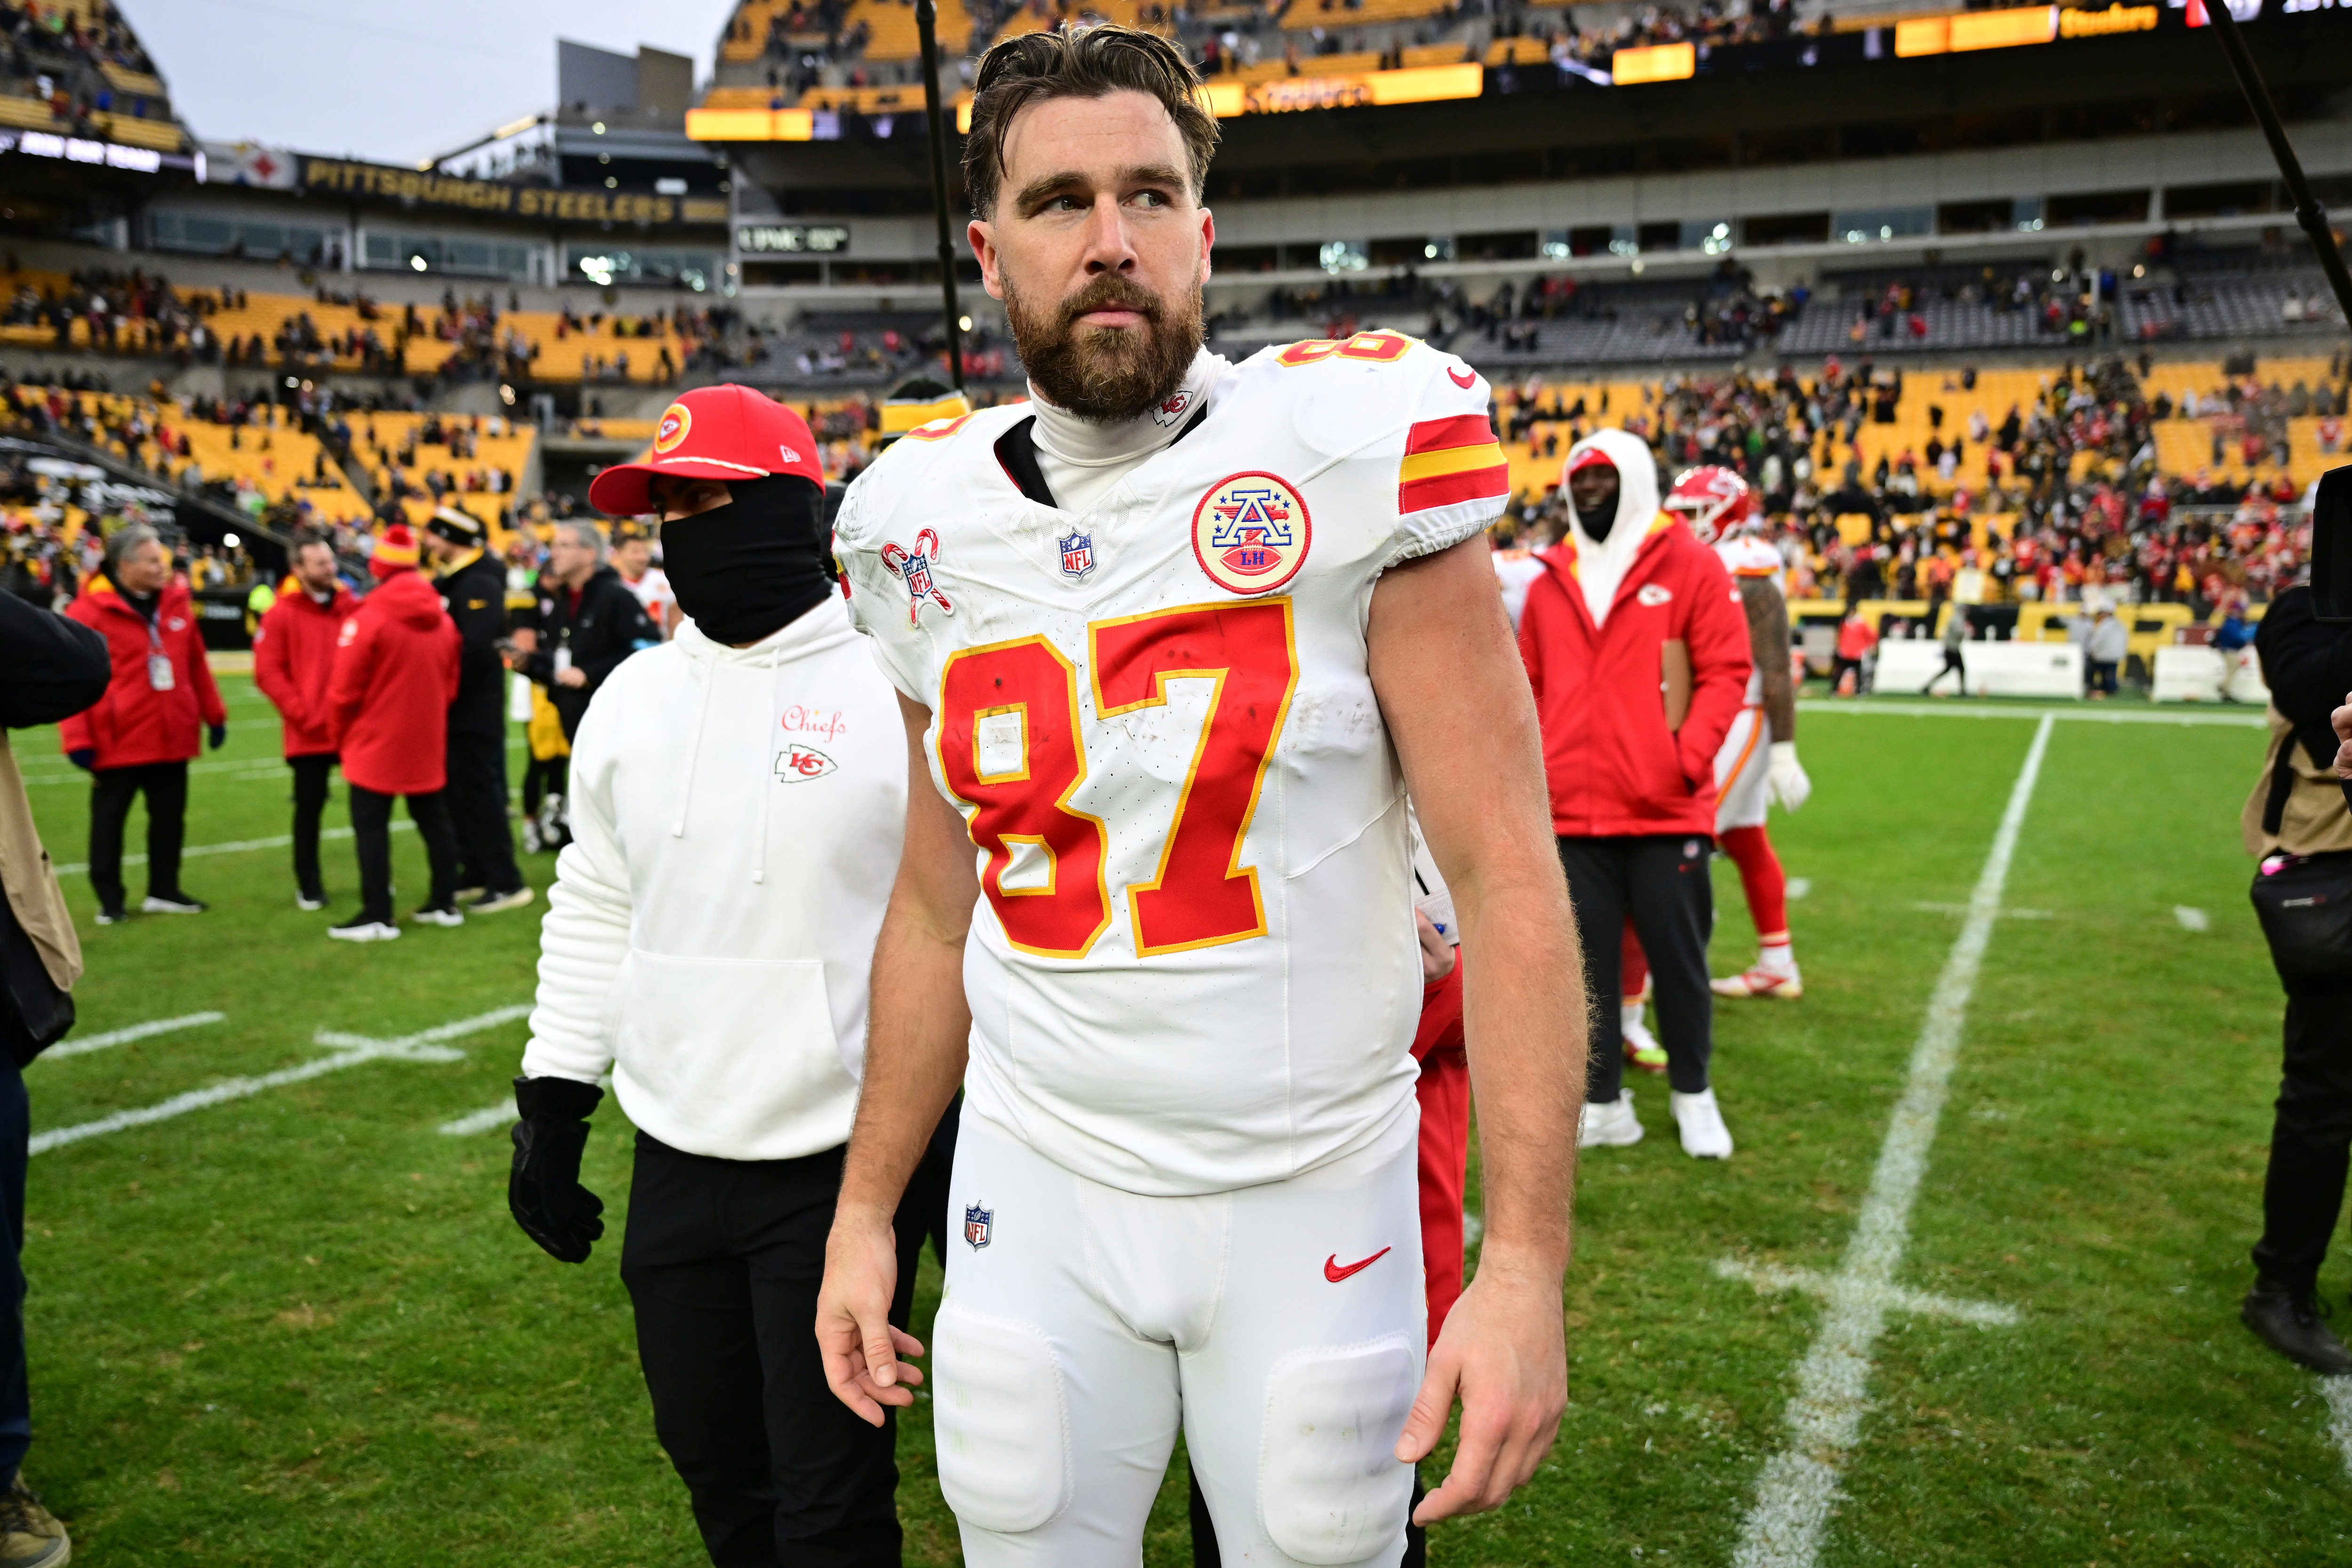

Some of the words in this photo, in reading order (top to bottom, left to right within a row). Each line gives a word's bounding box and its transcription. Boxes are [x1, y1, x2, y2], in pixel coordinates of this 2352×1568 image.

[307, 159, 511, 211] PITTSBURGH
[519, 188, 675, 223] STEELERS
[1160, 395, 1187, 414] KC
[1064, 550, 1090, 571] NFL
[1240, 551, 1264, 565] LH
[909, 571, 930, 593] NFL
[782, 705, 847, 743] Chiefs
[789, 753, 824, 776] KC
[936, 595, 1300, 959] 87
[967, 1222, 985, 1242] NFL
